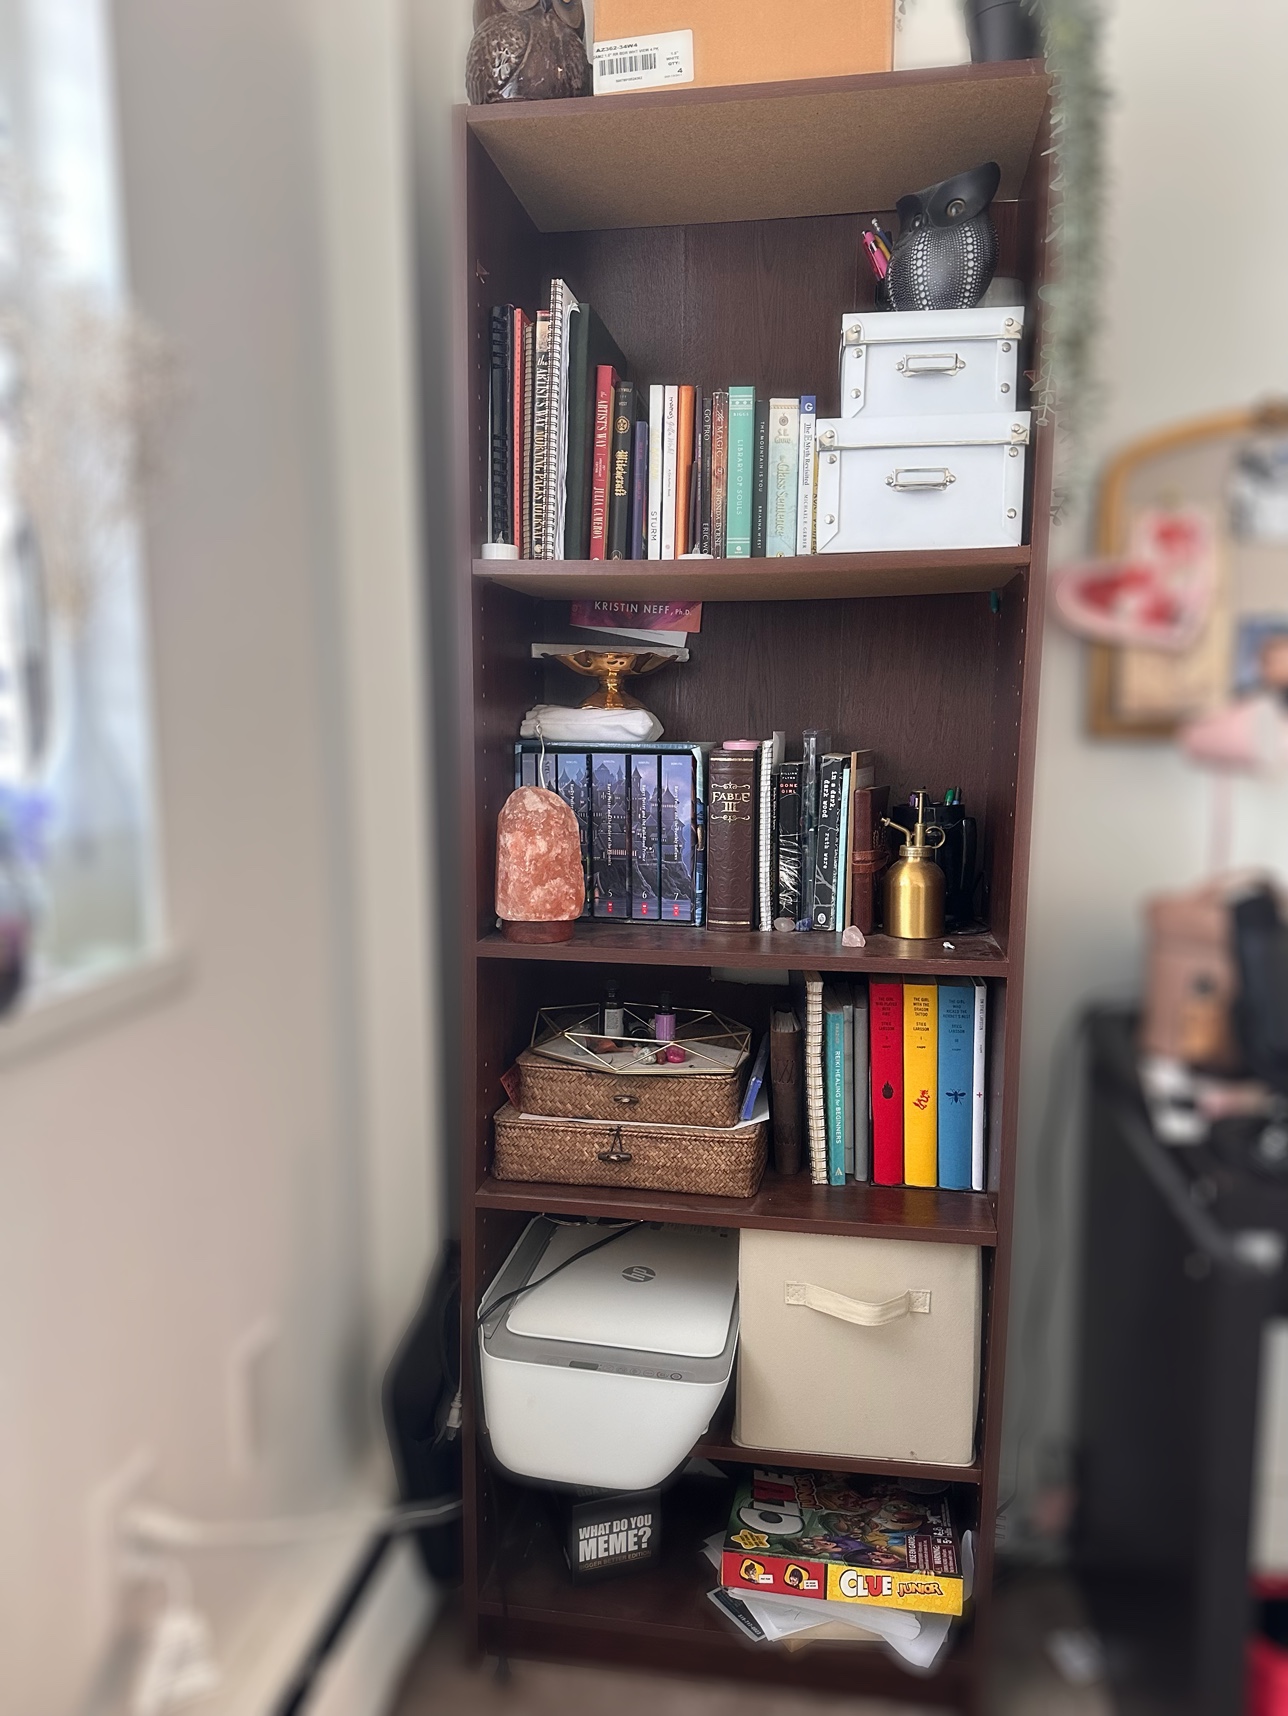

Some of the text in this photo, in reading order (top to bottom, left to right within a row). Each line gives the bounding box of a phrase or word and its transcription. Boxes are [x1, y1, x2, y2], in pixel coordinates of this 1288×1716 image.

[597, 400, 608, 431] ARTIST'S
[704, 409, 711, 422] GO
[804, 402, 813, 412] G
[535, 410, 547, 428] WAY
[596, 432, 606, 448] WAY
[716, 425, 724, 457] MAGIC
[534, 474, 544, 500] PAGES
[737, 476, 743, 486] OF
[593, 487, 604, 506] JULIA
[534, 502, 544, 541] JOURNAL
[592, 508, 604, 539] CAMERON
[650, 511, 658, 541] STURM
[594, 601, 692, 616] KRISTIN NEFF, Ph.D.
[831, 771, 838, 780] in
[712, 792, 750, 804] FABLE
[720, 801, 740, 813] III
[674, 892, 679, 900] 7
[622, 1265, 656, 1282] hp
[738, 1469, 805, 1535] CLUE
[579, 1514, 652, 1540] WHAT DO YOU
[579, 1526, 652, 1562] MEME?
[604, 1555, 626, 1564] BETTER
[628, 1550, 652, 1559] EDITION
[840, 1569, 943, 1598] CLUE JUNIOR
